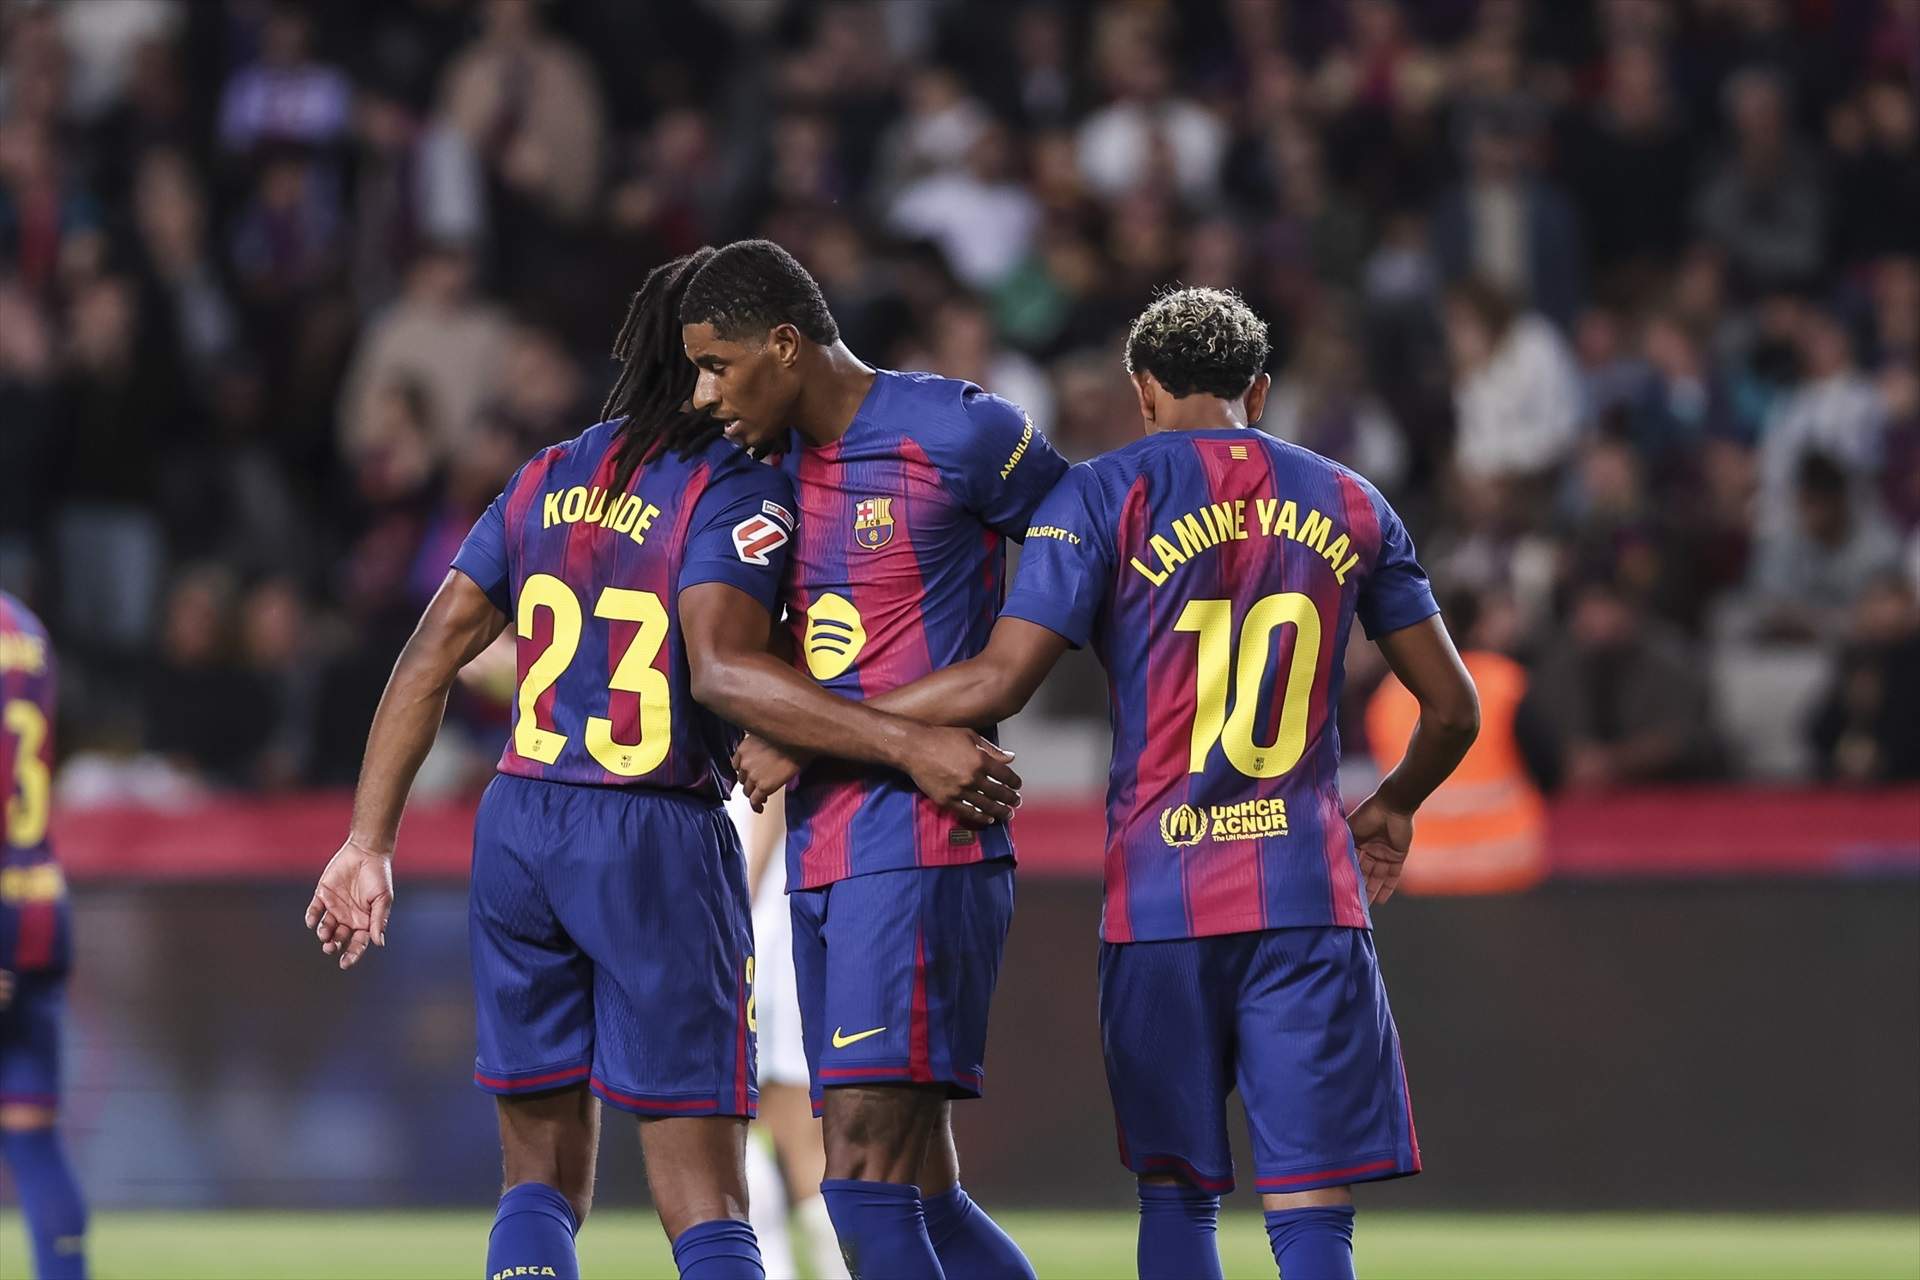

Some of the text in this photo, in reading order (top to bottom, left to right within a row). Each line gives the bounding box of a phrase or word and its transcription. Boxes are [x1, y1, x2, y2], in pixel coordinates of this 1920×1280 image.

[543, 486, 661, 545] KOUNDE
[1130, 498, 1359, 587] LAMINE YAMAL
[514, 573, 672, 776] 23
[1173, 591, 1321, 778] 10
[1211, 799, 1286, 820] UNHCR
[1211, 814, 1288, 835] ACNUR
[1212, 829, 1289, 842] The UN Refugee Agency
